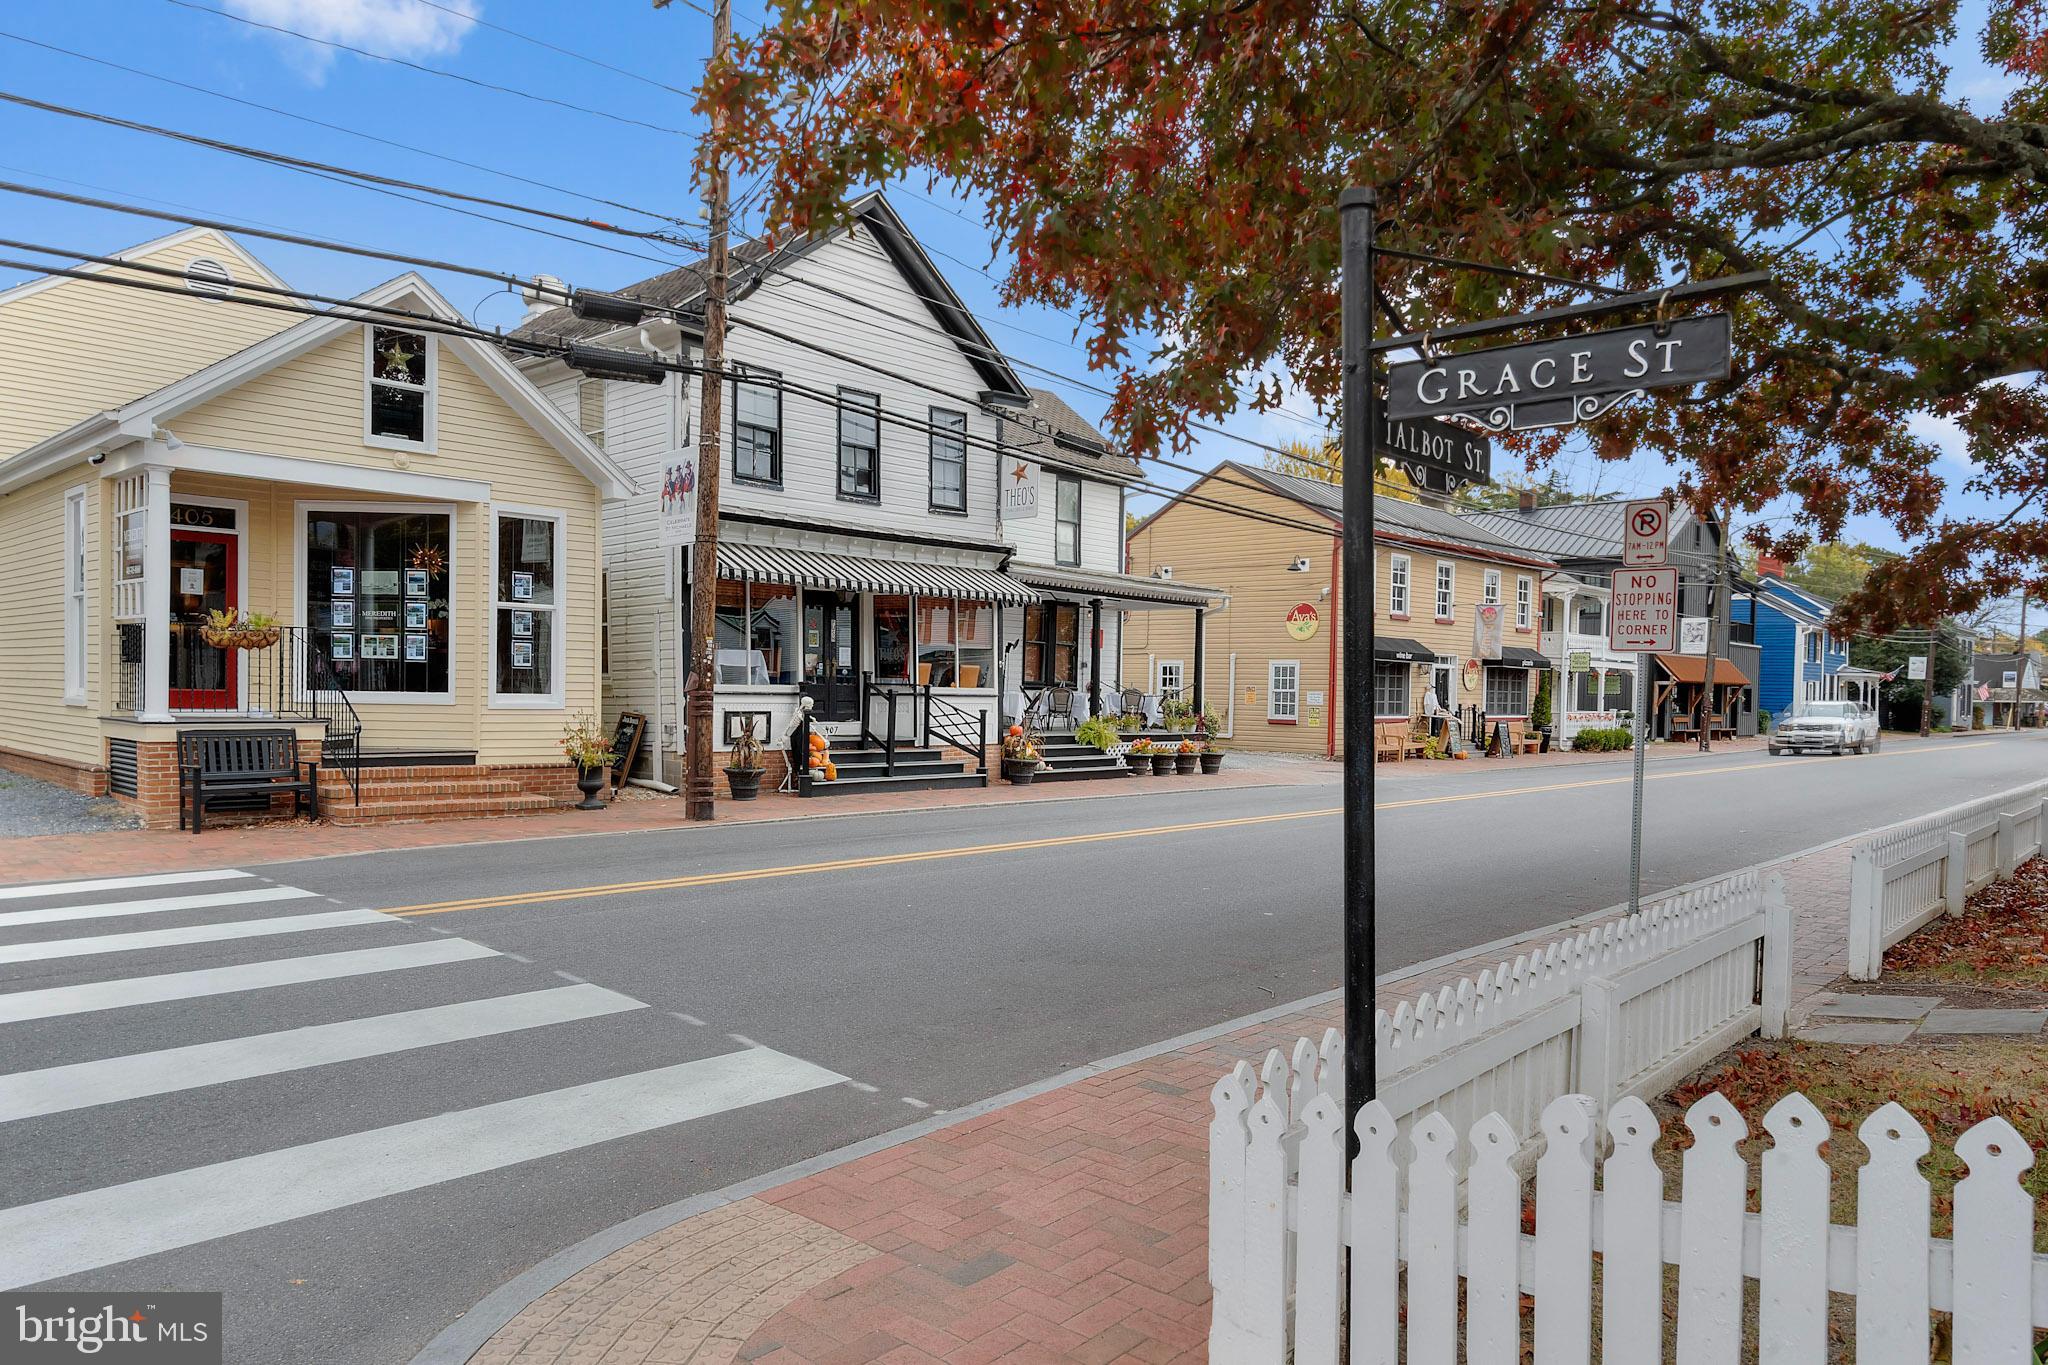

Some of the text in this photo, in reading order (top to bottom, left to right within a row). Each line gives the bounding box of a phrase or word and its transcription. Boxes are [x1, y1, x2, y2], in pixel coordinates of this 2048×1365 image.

[1416, 340, 1682, 405] GRACE ST
[1384, 413, 1486, 476] TALBOT ST.
[1004, 486, 1035, 508] THEO'S
[171, 507, 214, 526] 405
[1631, 575, 1657, 590] NO
[1615, 592, 1672, 606] STOPPING
[1292, 609, 1317, 622] Ava's
[1617, 609, 1669, 622] HERE TO
[1617, 625, 1668, 636] CORNER
[825, 725, 838, 733] 407
